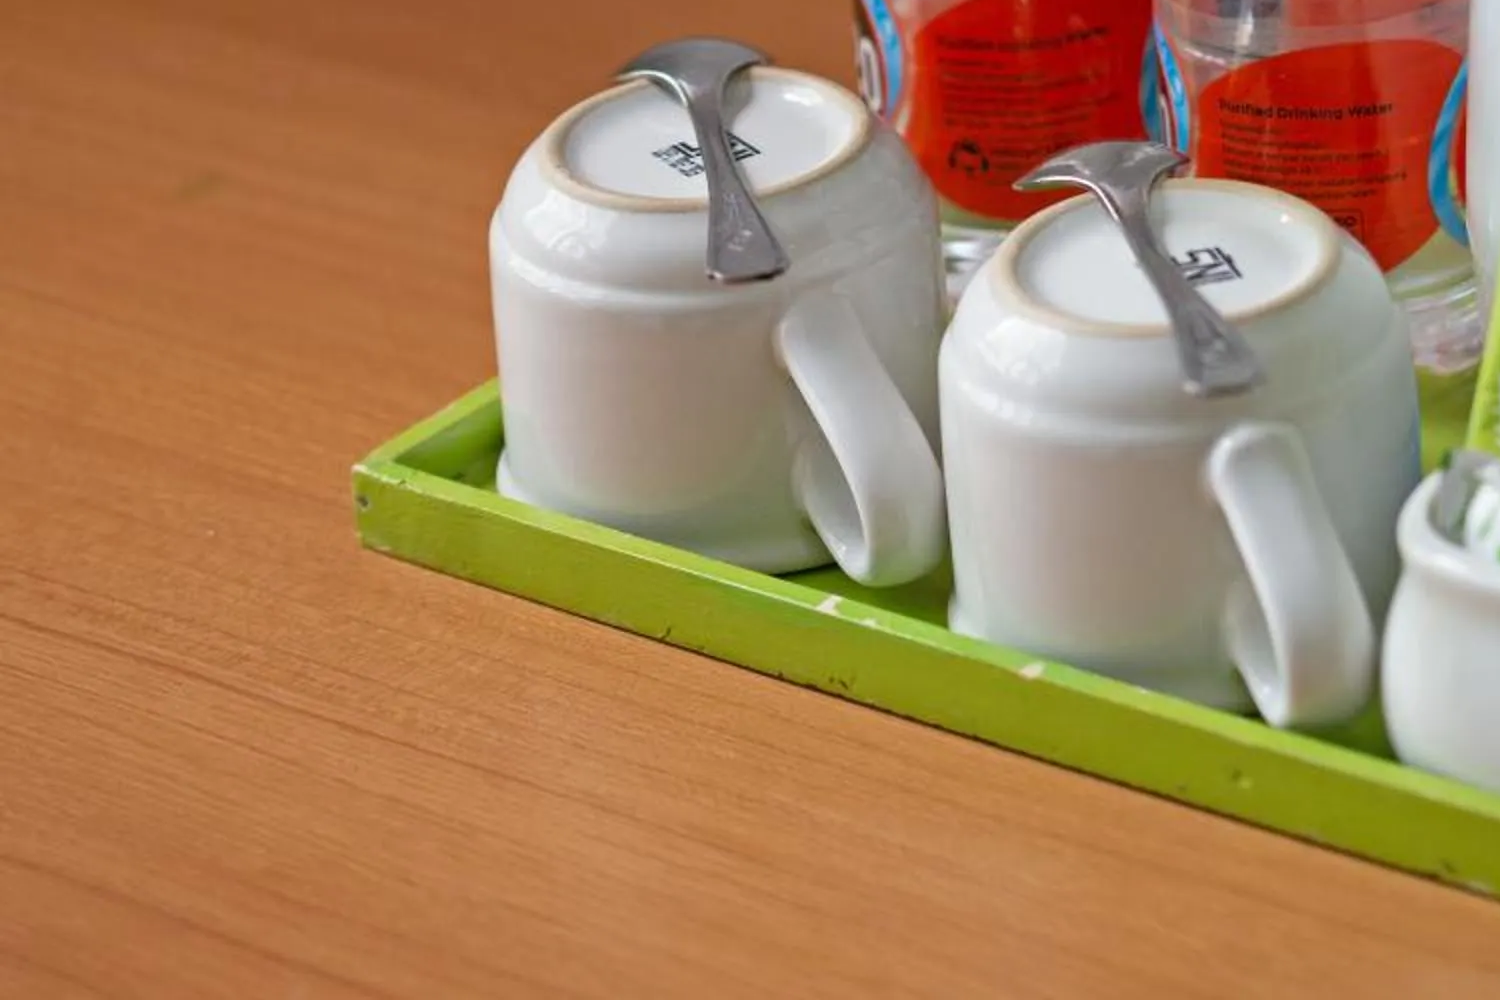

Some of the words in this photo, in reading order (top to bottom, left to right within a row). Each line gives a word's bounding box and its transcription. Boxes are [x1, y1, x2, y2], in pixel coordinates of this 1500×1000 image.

[1219, 98, 1273, 119] Purified
[1276, 106, 1344, 121] Drinking
[1347, 101, 1393, 118] Water
